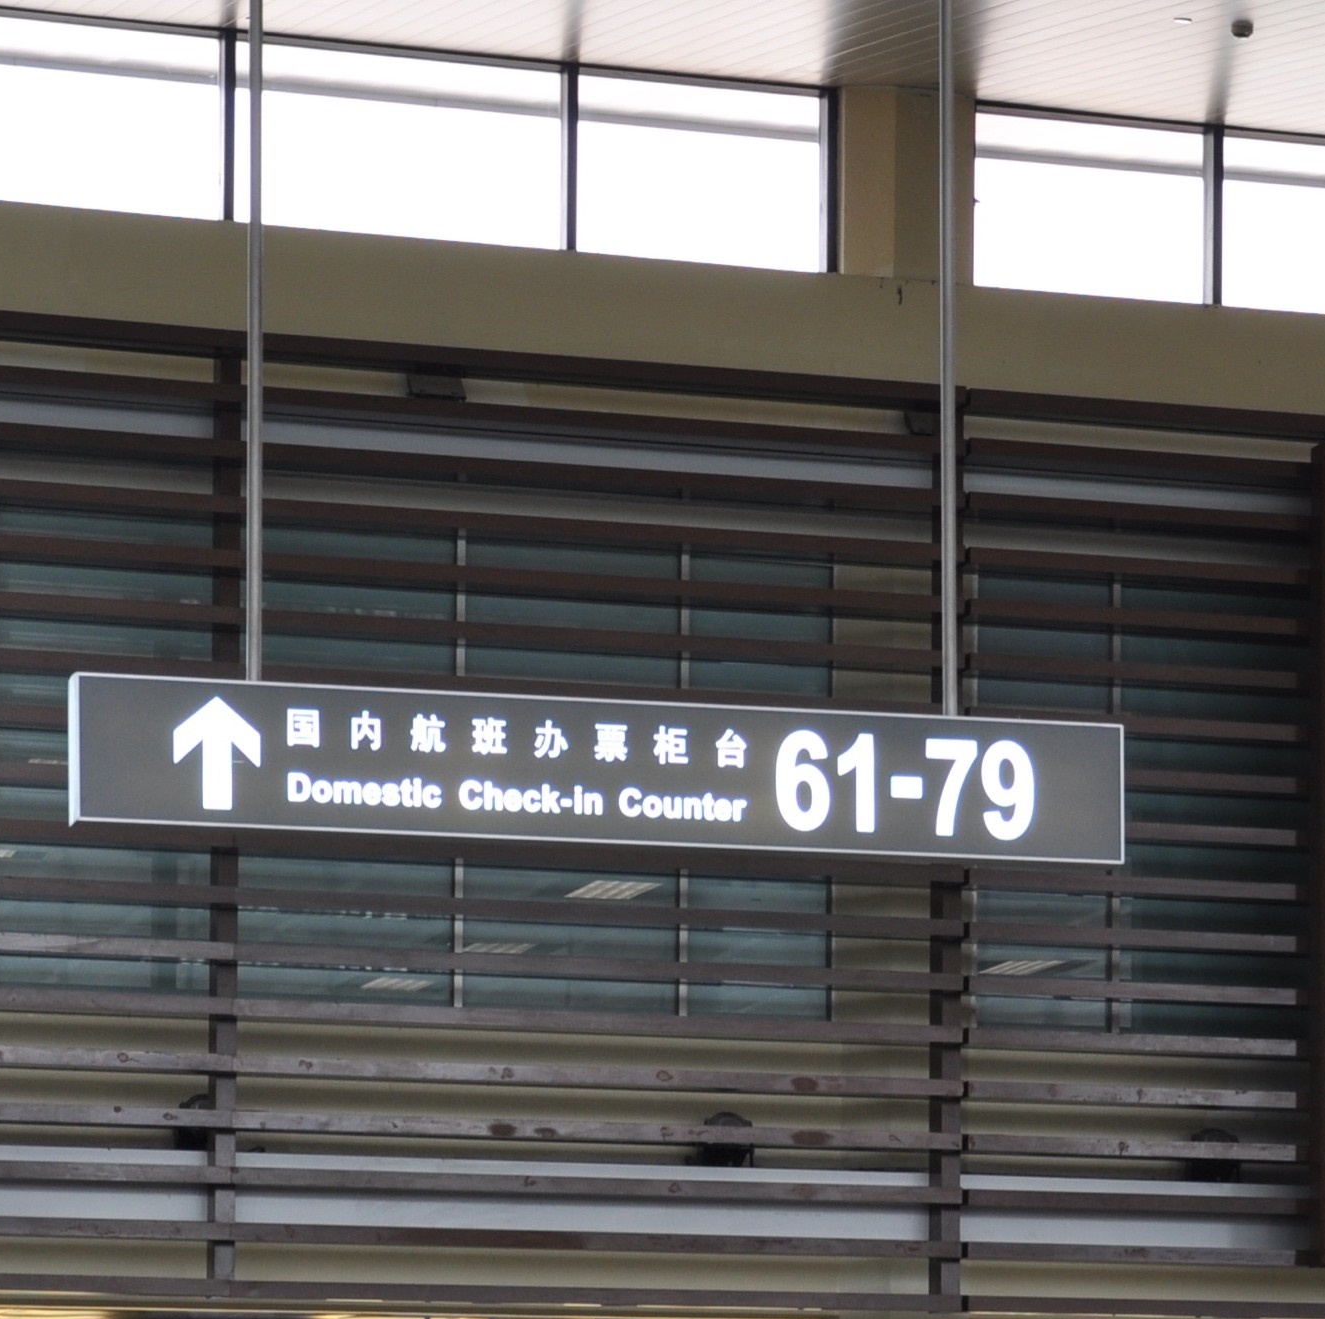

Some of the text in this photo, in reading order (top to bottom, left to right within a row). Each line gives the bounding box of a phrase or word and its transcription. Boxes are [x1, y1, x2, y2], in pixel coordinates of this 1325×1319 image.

[286, 708, 748, 770] 国内航班办票柜台
[288, 772, 748, 823] Domestic Check-in Counter
[775, 730, 1034, 841] 61-79
